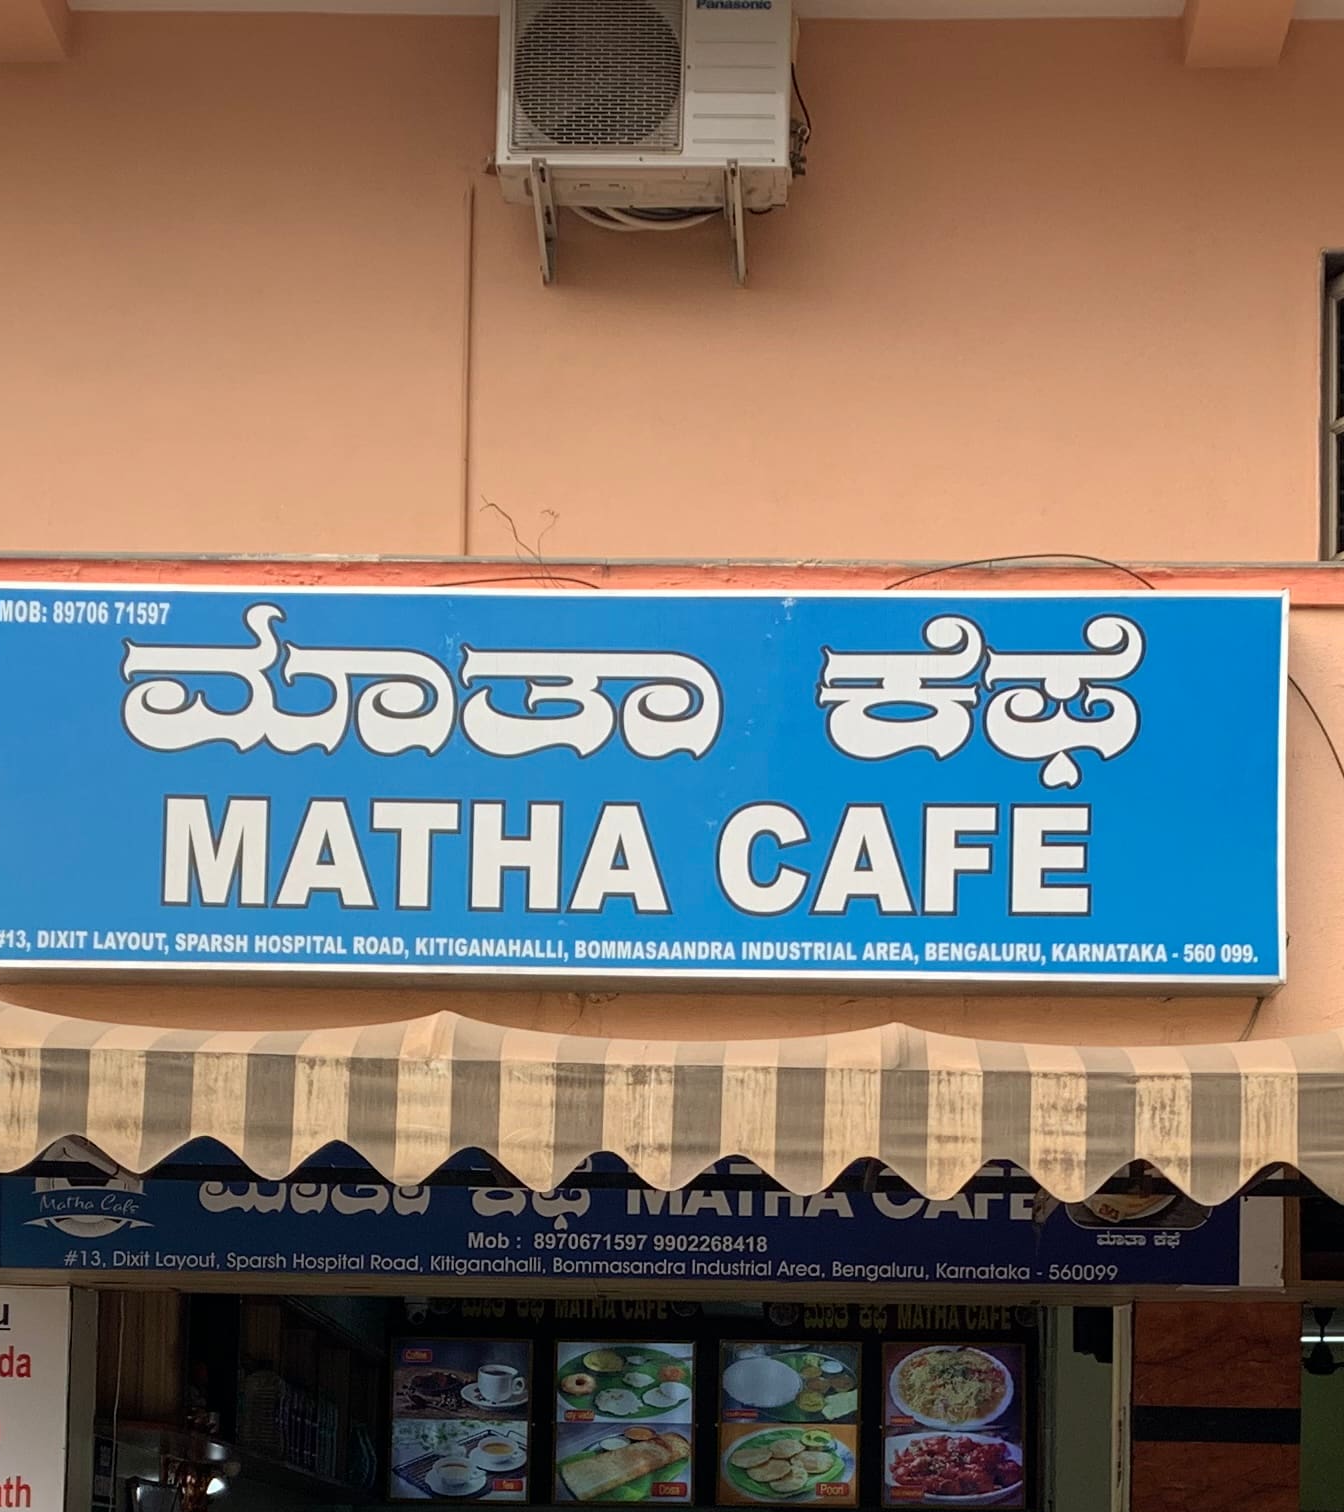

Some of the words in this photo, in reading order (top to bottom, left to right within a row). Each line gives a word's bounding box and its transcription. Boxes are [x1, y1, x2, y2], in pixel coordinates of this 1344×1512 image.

[0, 599, 48, 623] MOB:
[53, 600, 108, 624] 89706
[115, 601, 170, 625] 71597
[121, 602, 723, 760] ಮಾತಾ
[160, 796, 675, 914] MATHA
[718, 799, 1093, 917] CAFE
[37, 931, 88, 950] DIXIT
[93, 932, 169, 955] LAYOUT,
[176, 933, 248, 953] SPARSH
[255, 934, 347, 955] HOSPITAL
[354, 936, 409, 960] ROAD,
[416, 937, 568, 963] KITIGANAHALLI,
[575, 940, 736, 962] BOMMASAANDRA
[742, 942, 856, 963] INDUSTRIAL
[863, 943, 918, 965] AREA,
[926, 944, 1046, 966] BENGALURU,
[1052, 944, 1167, 963] KARNATAKA
[1184, 944, 1216, 963] 560
[533, 1232, 647, 1251] 8970671597
[653, 1234, 767, 1254] 9902268418
[64, 1250, 106, 1268] #13,
[112, 1250, 151, 1268] Dixit
[156, 1251, 221, 1274] Layout,
[226, 1252, 286, 1275] Sparsh
[293, 1252, 364, 1275] Hospital
[371, 1253, 423, 1275] Road,
[430, 1254, 545, 1278] Kitiganahalli,
[553, 1256, 685, 1277] Bommasandra
[691, 1258, 772, 1277] Industrial
[832, 1260, 927, 1284] Bengaluru,
[936, 1261, 1030, 1281] Karnataka
[1048, 1263, 1118, 1282] 560099
